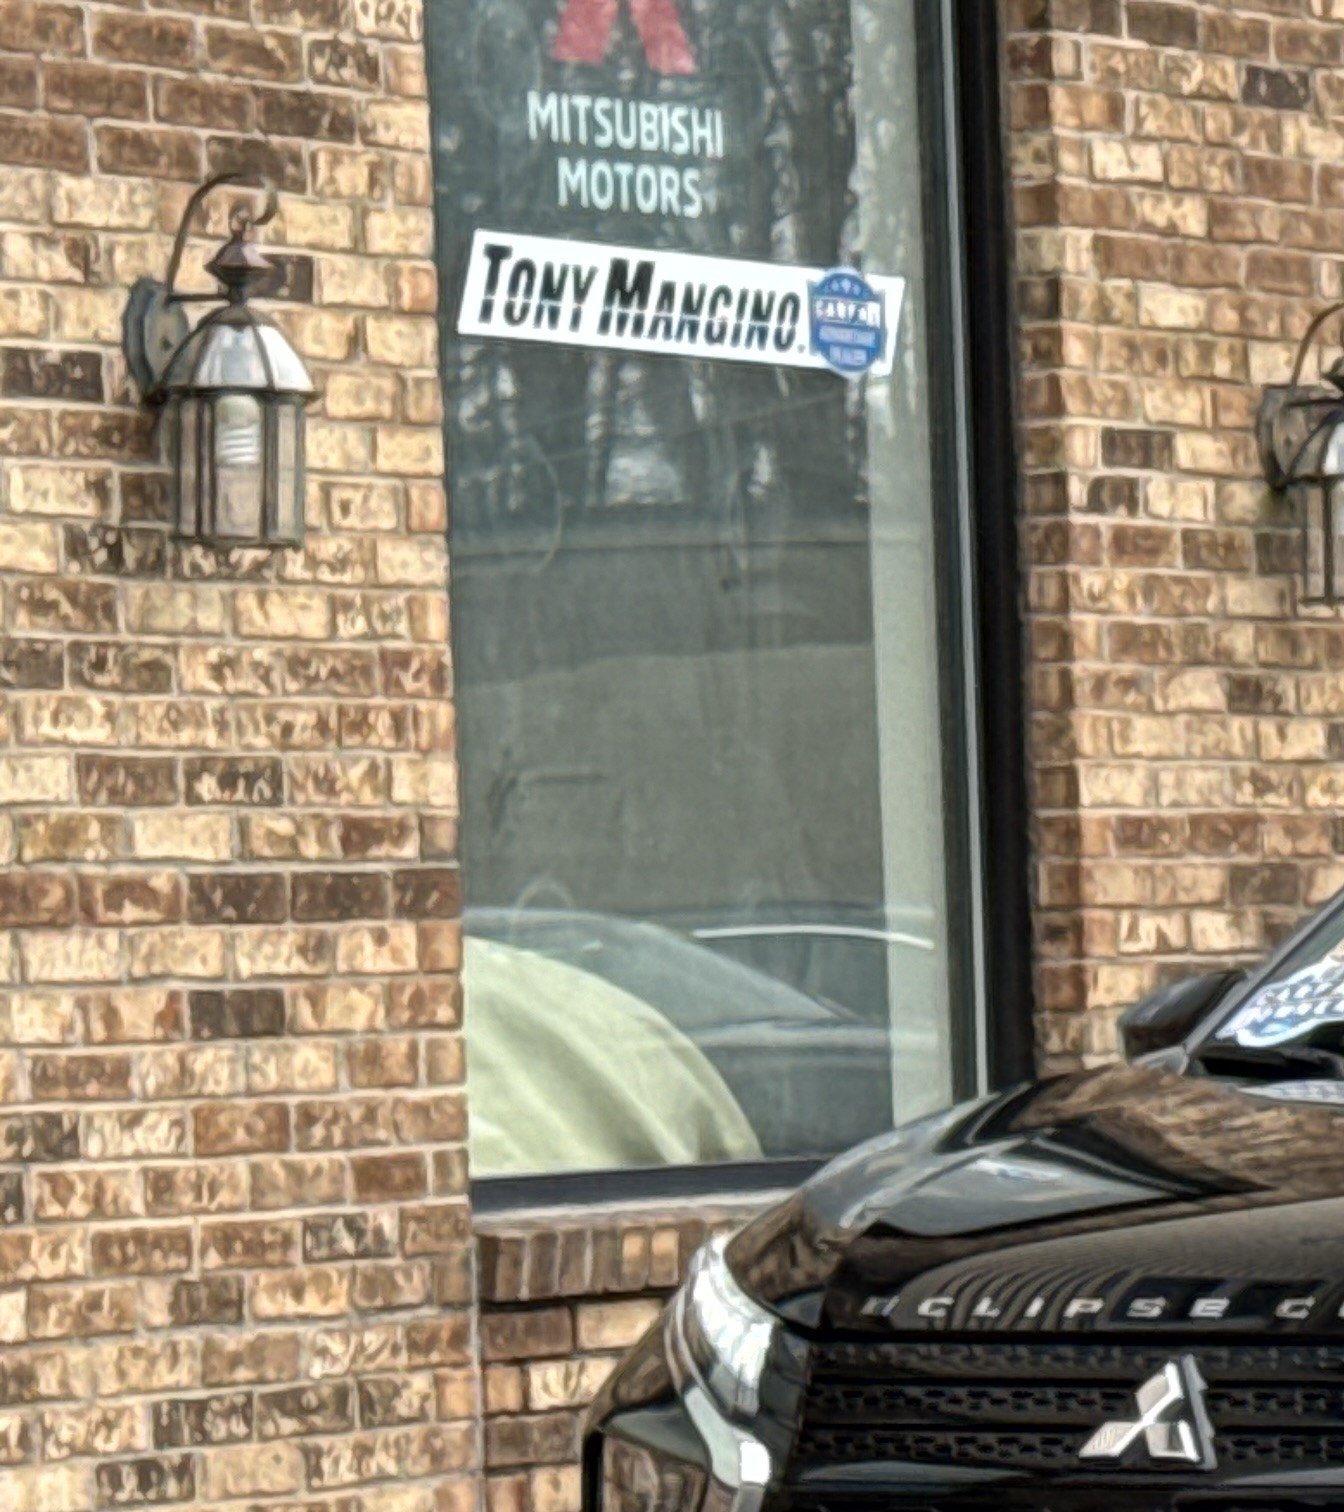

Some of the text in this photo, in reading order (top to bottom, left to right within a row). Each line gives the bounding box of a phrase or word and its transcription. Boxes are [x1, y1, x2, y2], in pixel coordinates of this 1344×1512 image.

[527, 90, 724, 159] MITSUBISHI
[557, 156, 703, 219] MOTORS
[478, 243, 599, 334] TONY
[860, 1295, 1230, 1319] ECLIPSE
